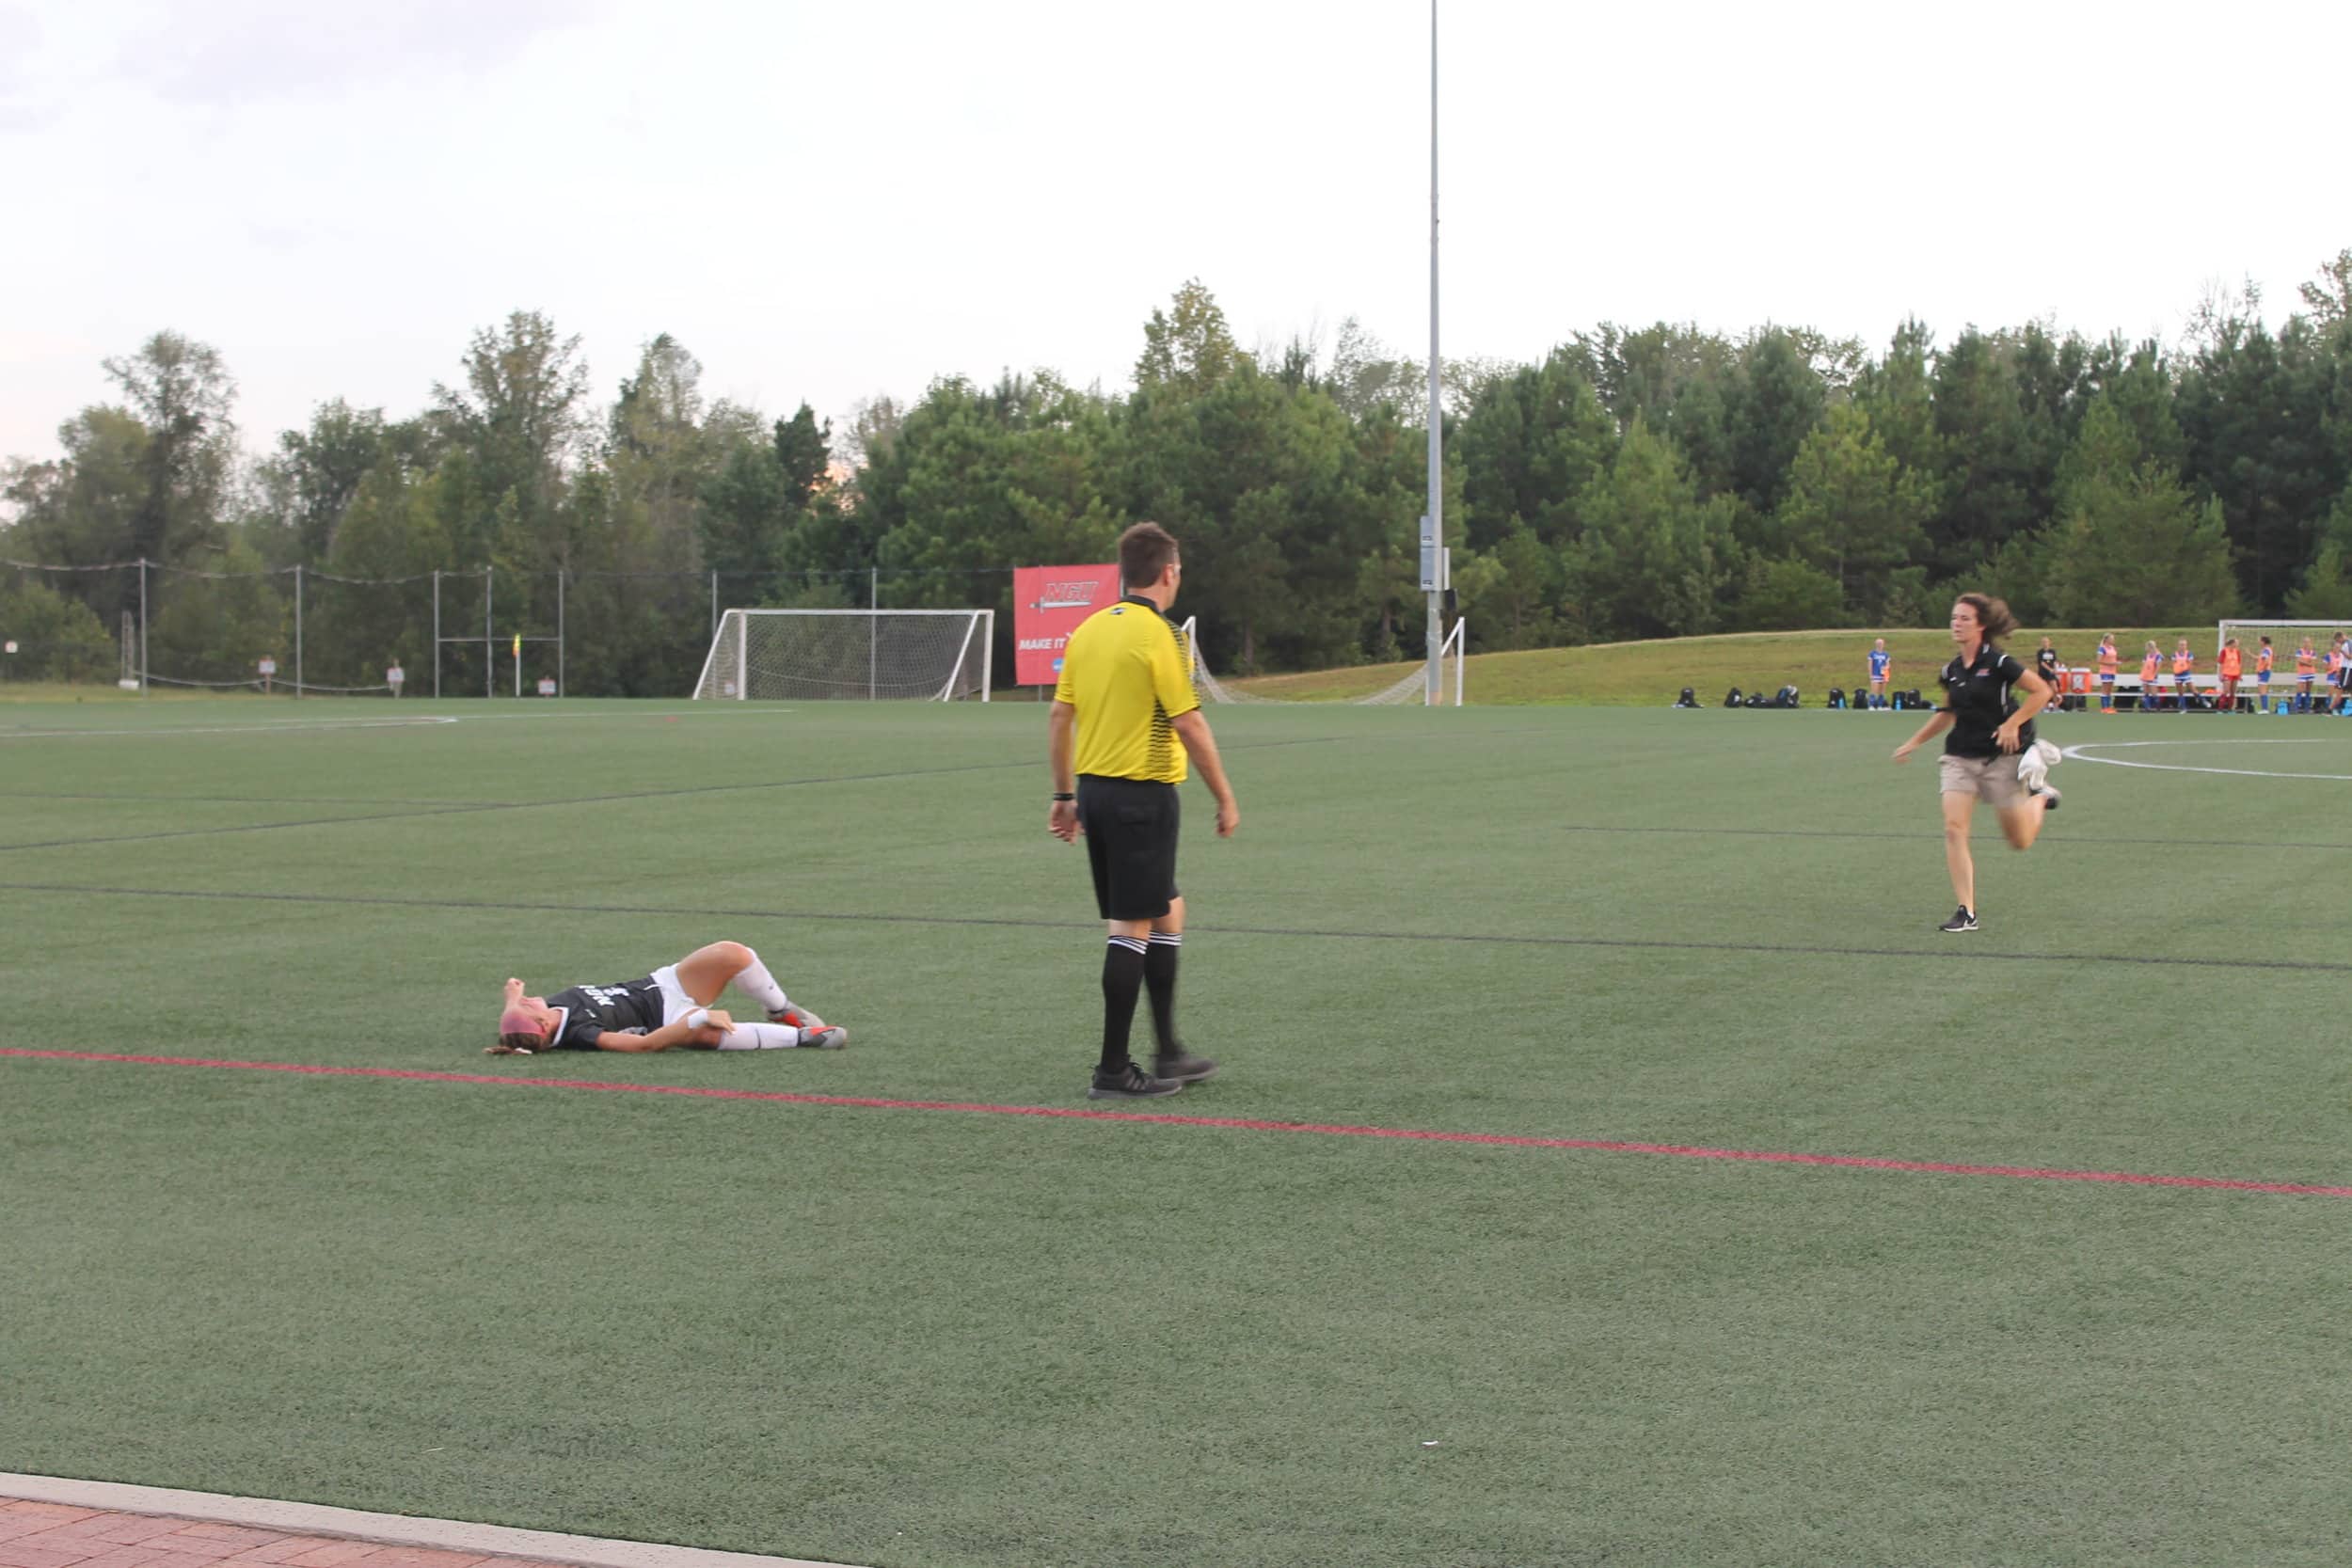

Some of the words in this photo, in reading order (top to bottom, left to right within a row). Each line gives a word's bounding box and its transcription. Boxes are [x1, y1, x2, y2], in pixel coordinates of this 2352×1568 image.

[1045, 581, 1099, 602] NGU
[1018, 638, 1052, 650] MAKE
[1054, 637, 1066, 648] IT
